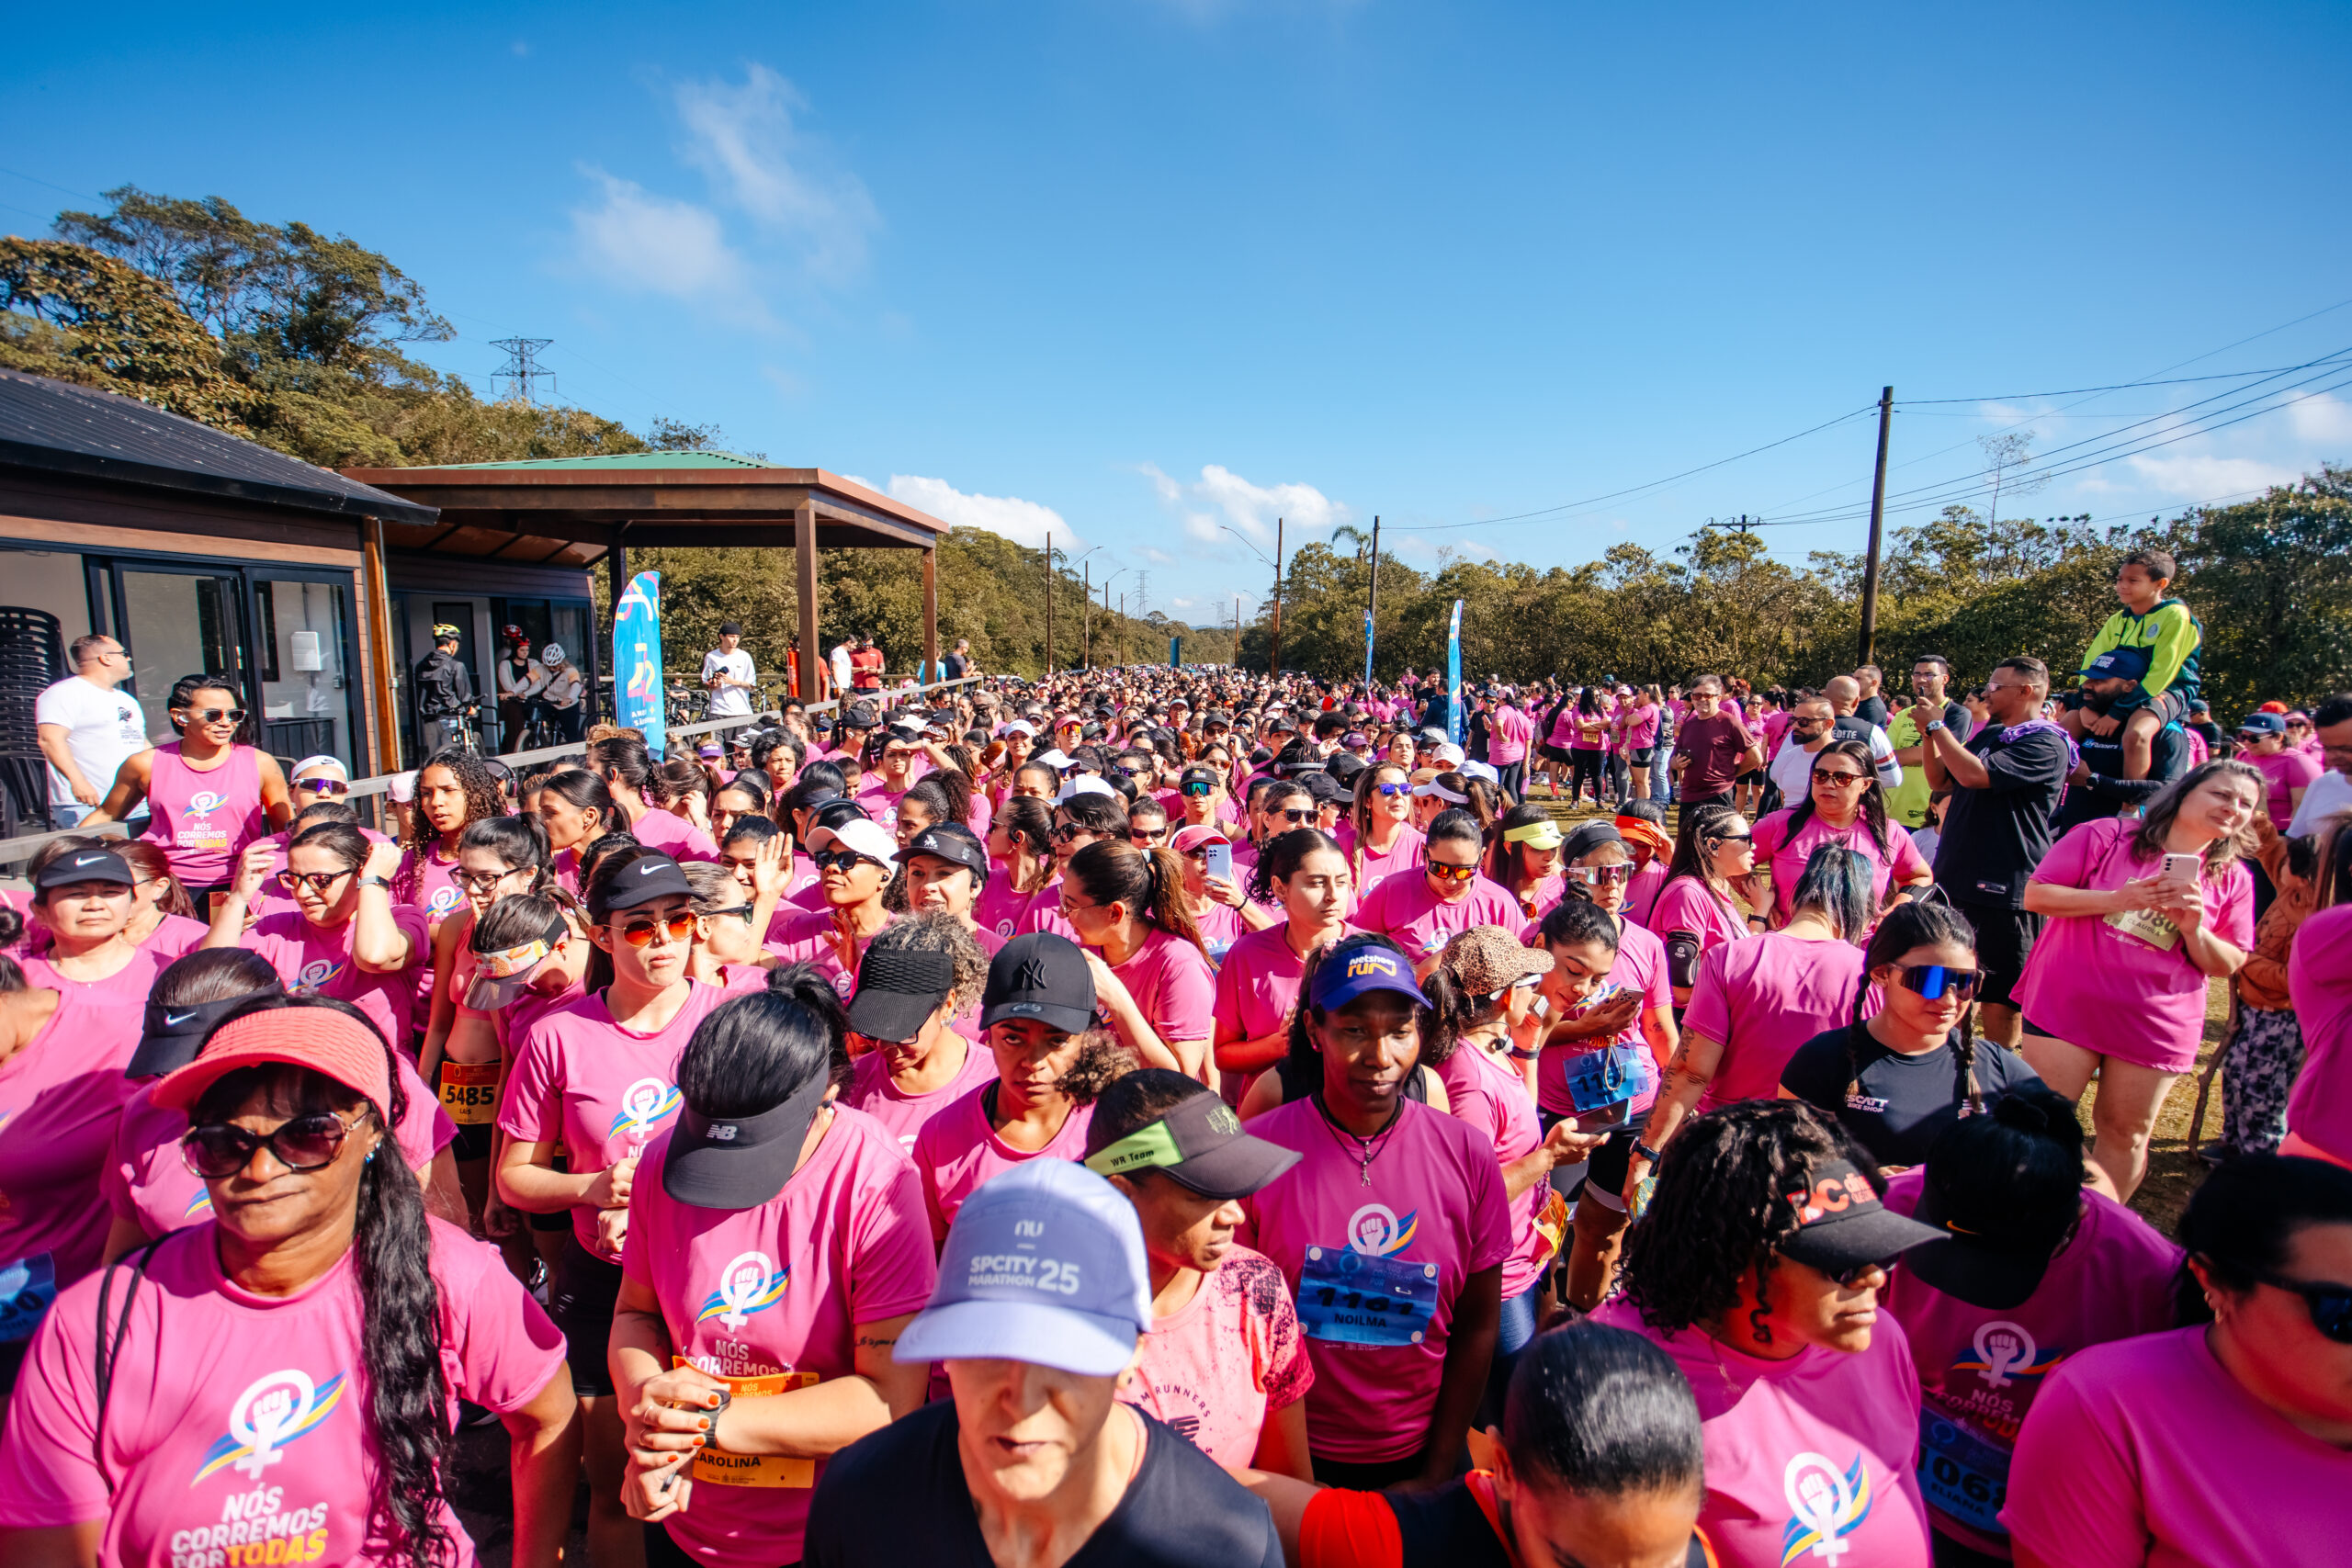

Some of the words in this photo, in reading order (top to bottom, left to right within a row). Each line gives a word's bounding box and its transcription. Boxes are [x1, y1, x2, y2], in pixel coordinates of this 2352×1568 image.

[177, 830, 227, 840] CORREMOS
[194, 821, 212, 831] NÓS
[2124, 906, 2177, 933] 080
[445, 1085, 494, 1106] 5485
[1847, 1094, 1889, 1108] SCATT
[1862, 1105, 1884, 1113] SHOP
[1110, 1156, 1126, 1168] WR
[1128, 1148, 1155, 1163] Team
[967, 1273, 1035, 1287] MARATHON
[1036, 1258, 1080, 1295] 25
[1334, 1312, 1387, 1328] NOILMA
[715, 1337, 750, 1361] NÓS
[1155, 1383, 1211, 1418] RUNNERS
[1971, 1388, 2014, 1413] NÓS
[695, 1451, 762, 1468] AROLINA
[221, 1482, 284, 1522] NÓS
[1930, 1482, 1985, 1516] ELIANA
[170, 1501, 329, 1554] CORREMOS
